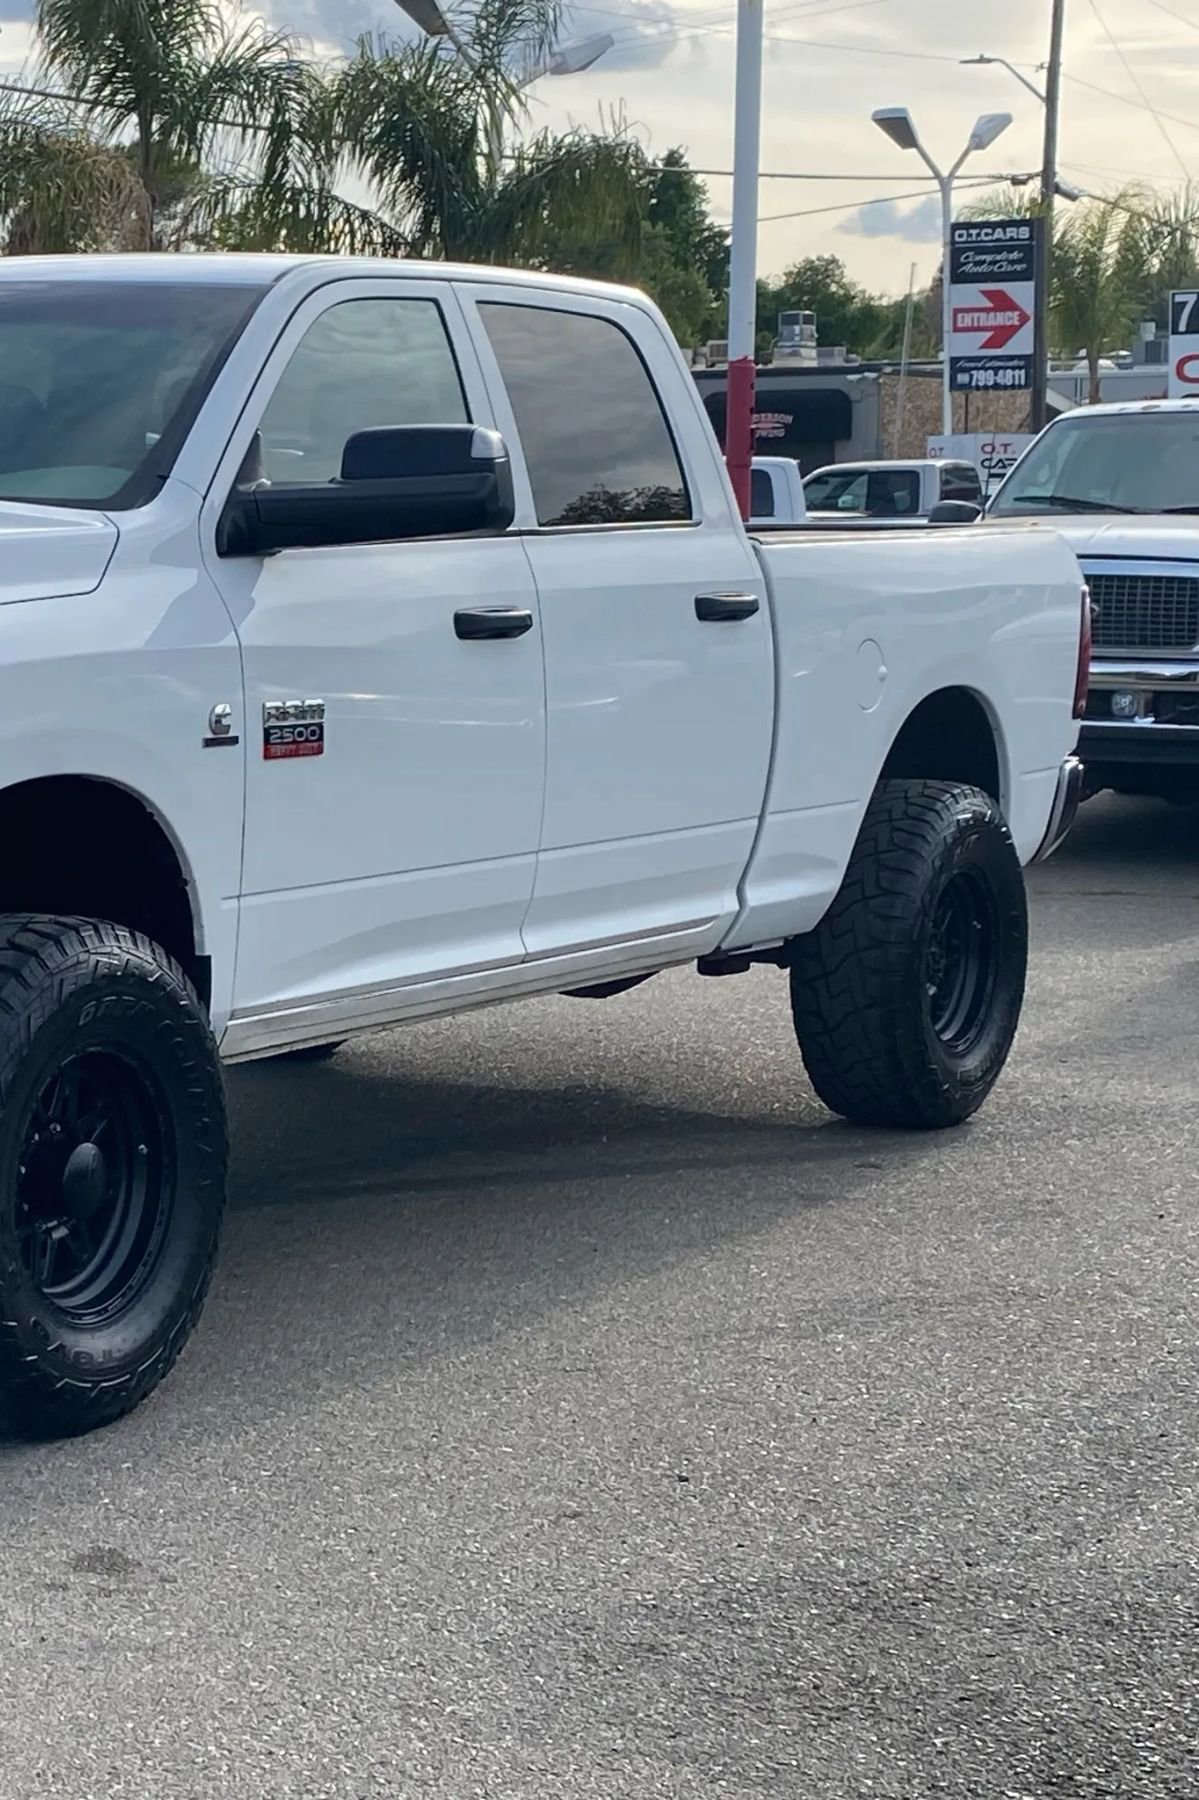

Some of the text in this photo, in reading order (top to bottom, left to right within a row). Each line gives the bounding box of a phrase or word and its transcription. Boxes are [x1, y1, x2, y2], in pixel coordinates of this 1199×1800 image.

[960, 250, 1024, 264] Complete
[957, 261, 1028, 274] Auto Care
[956, 311, 1021, 328] ENTRANCE
[1174, 293, 1198, 332] 7
[970, 368, 1026, 386] 799-4811
[268, 726, 320, 744] 2500
